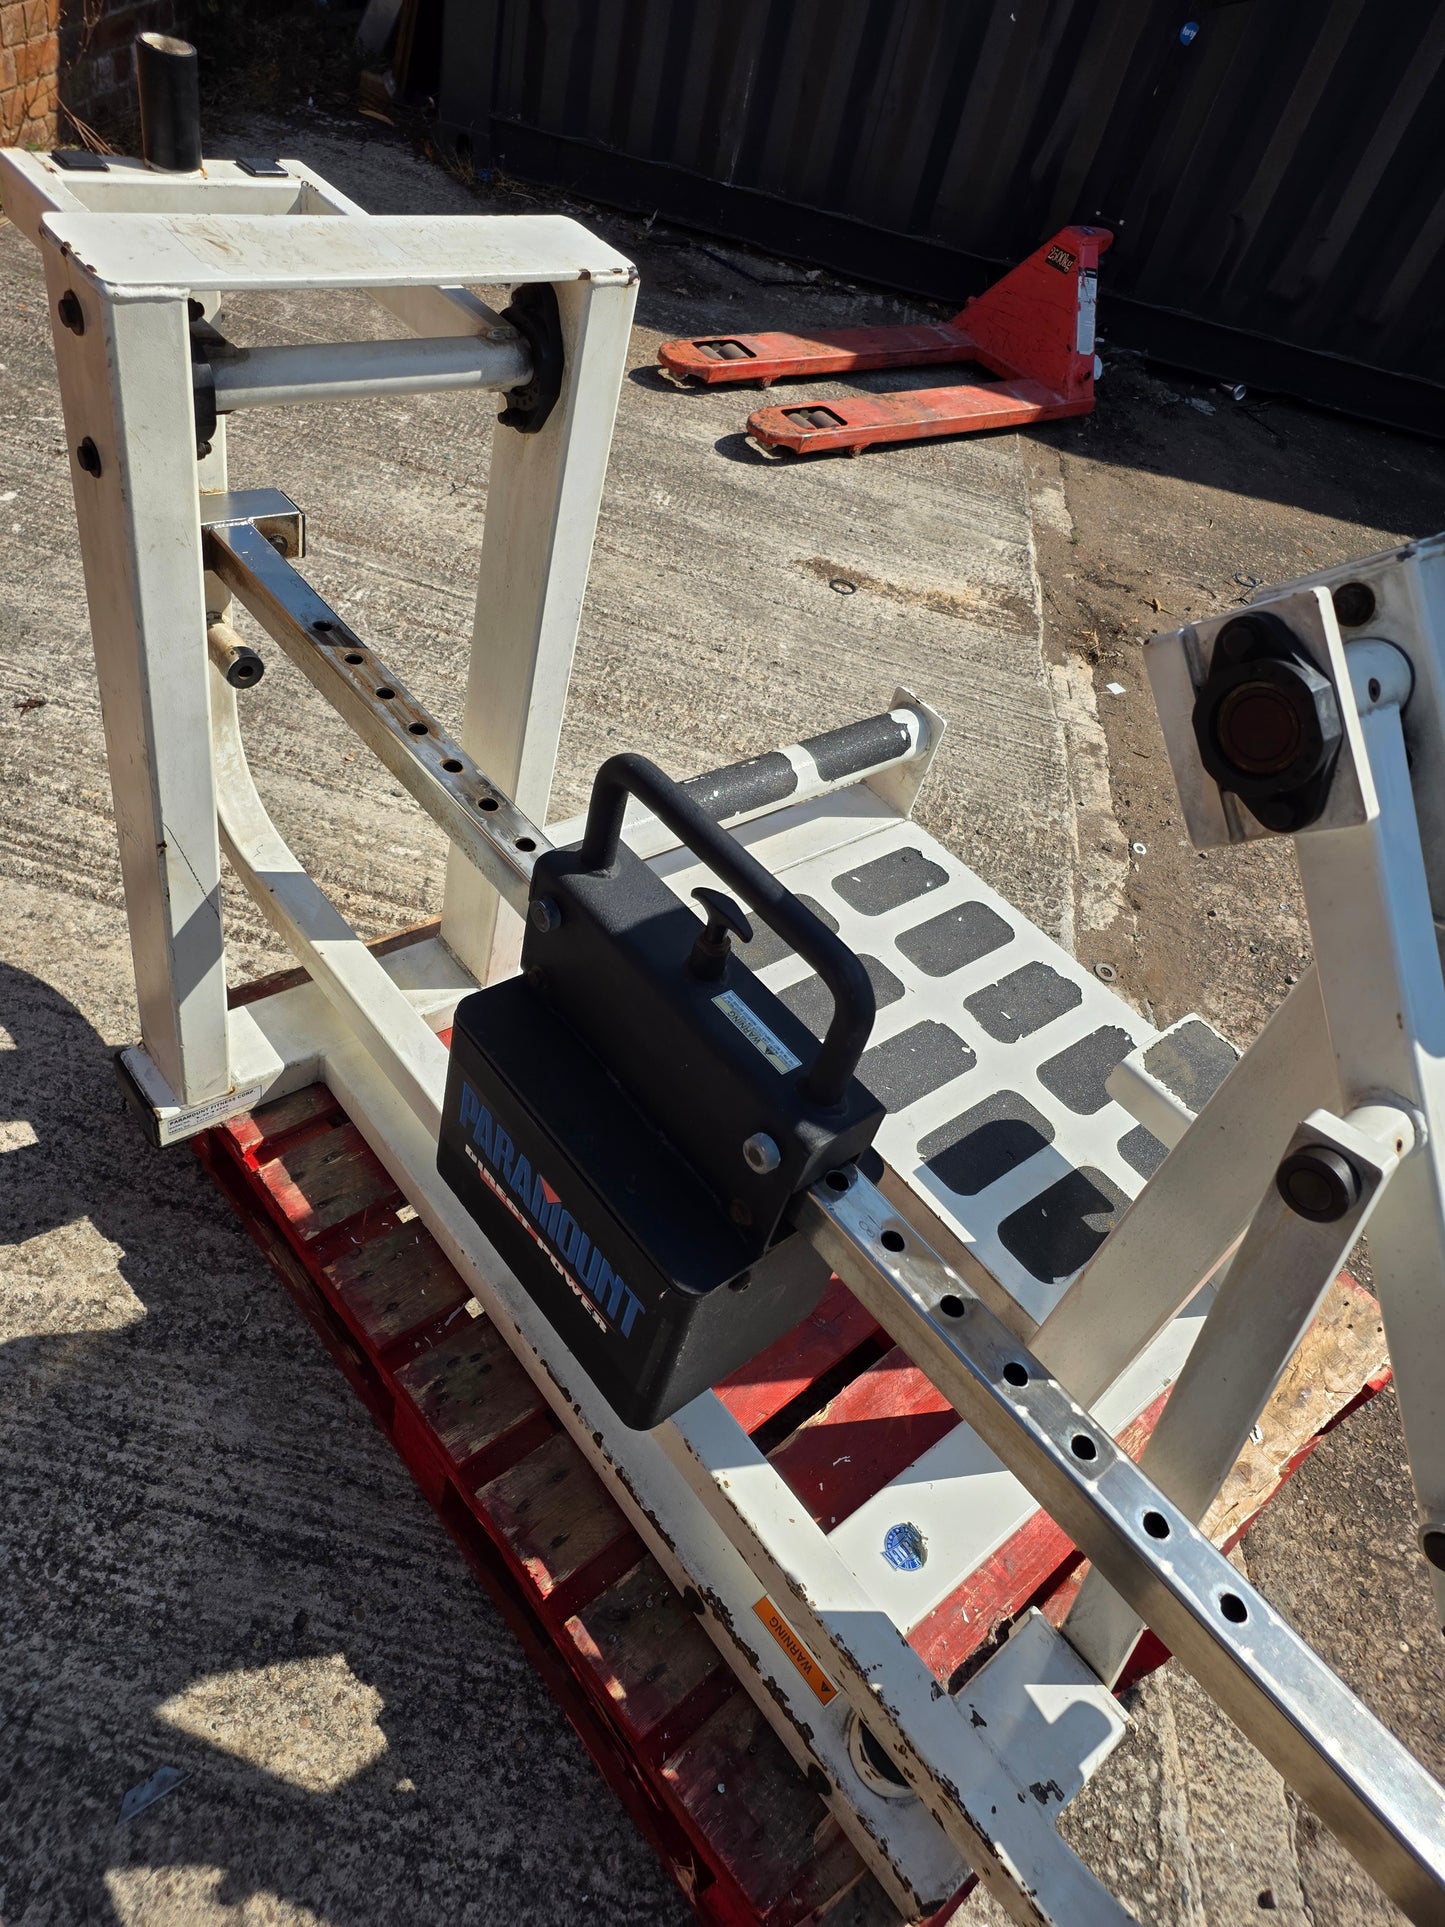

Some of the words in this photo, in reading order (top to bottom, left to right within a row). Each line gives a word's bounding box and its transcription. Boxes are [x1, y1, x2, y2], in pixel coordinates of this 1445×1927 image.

[1047, 246, 1074, 273] 2500kg
[728, 1010, 761, 1044] WARNING
[169, 1107, 209, 1126] PARAMOUNT
[210, 1096, 236, 1110] FITNESS
[459, 1081, 646, 1339] PARAMOUNT
[465, 1143, 531, 1230] DIRECT
[536, 1237, 608, 1334] POWER
[769, 1616, 813, 1675] WARNING
